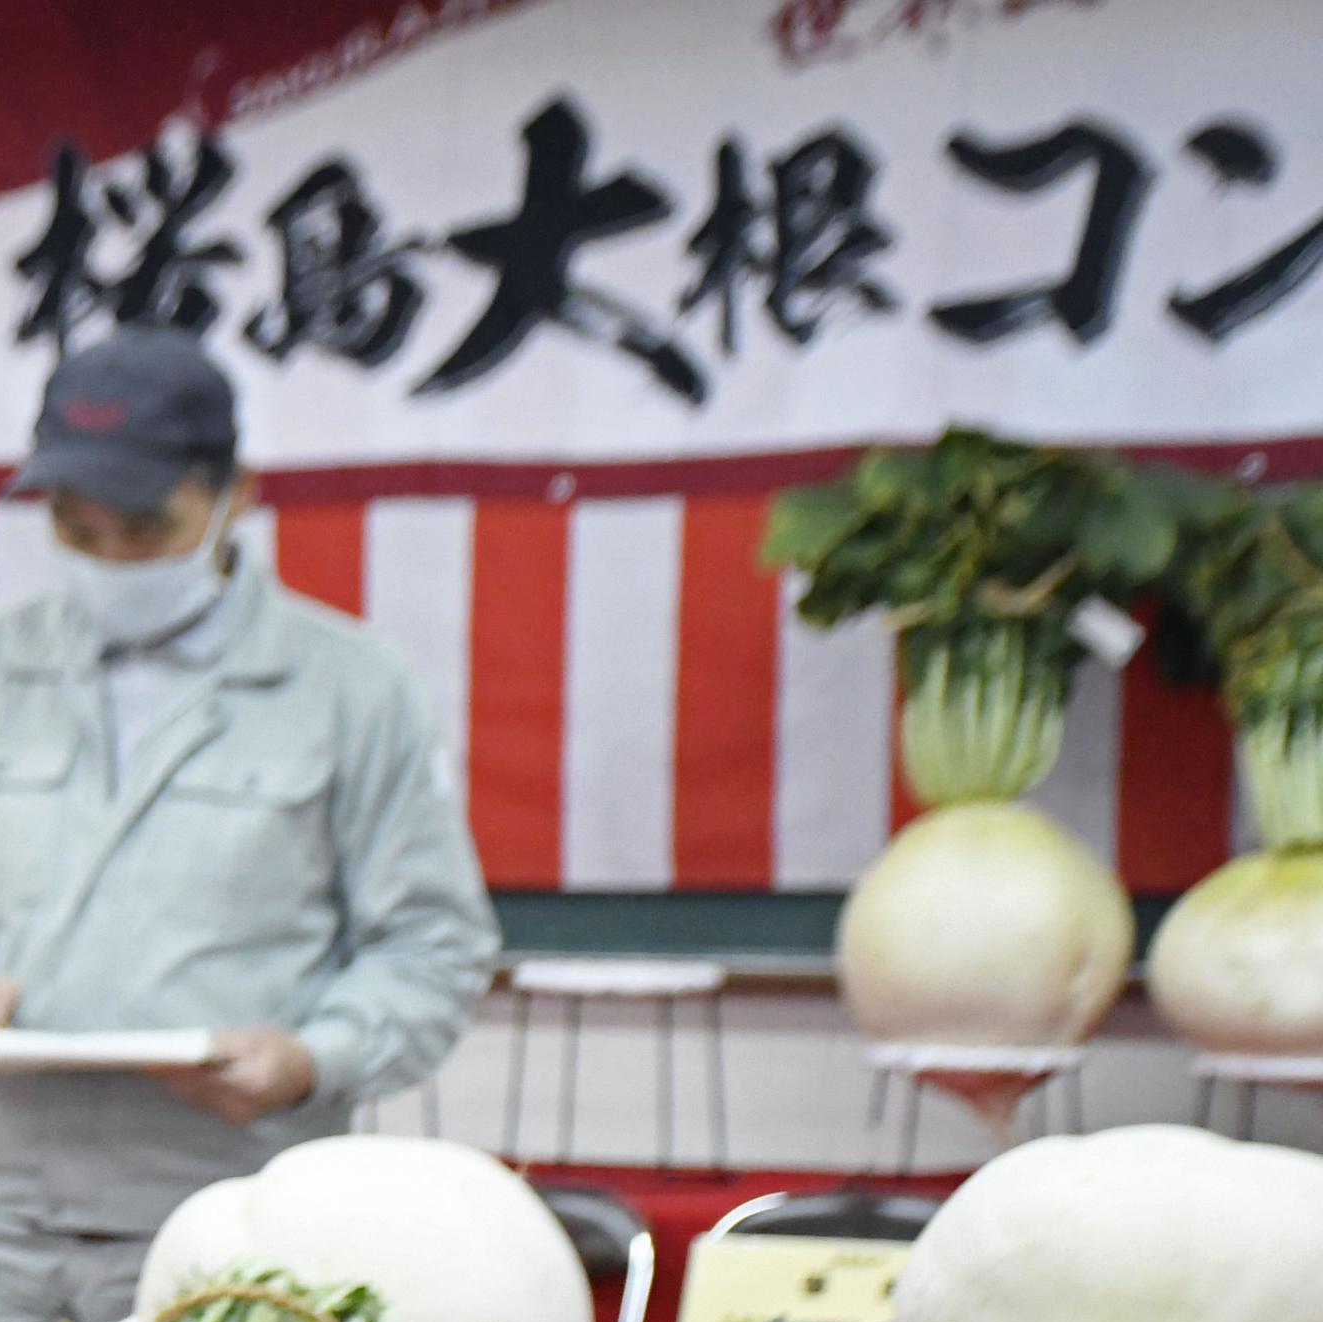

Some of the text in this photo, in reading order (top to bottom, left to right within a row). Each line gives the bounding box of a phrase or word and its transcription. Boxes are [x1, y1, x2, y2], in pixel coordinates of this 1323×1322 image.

[10, 94, 1323, 406] 桜島大根コン
